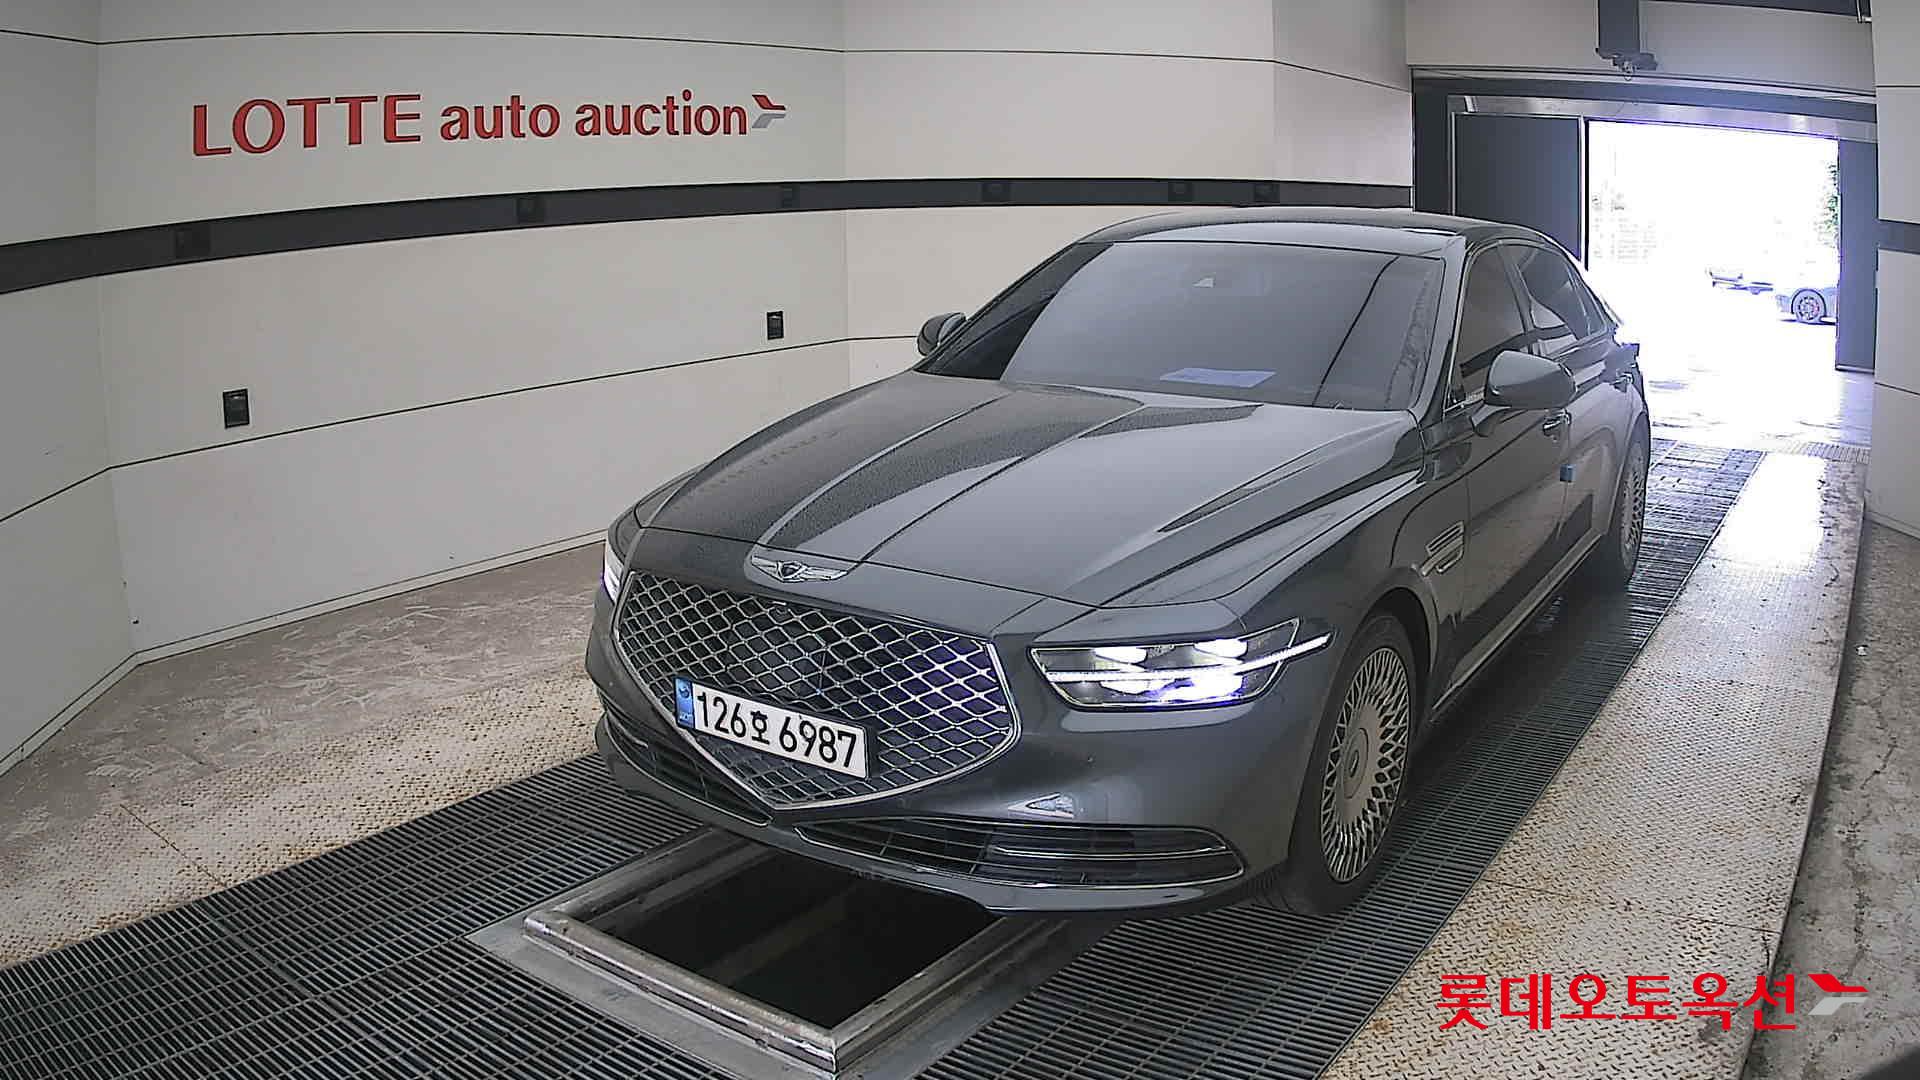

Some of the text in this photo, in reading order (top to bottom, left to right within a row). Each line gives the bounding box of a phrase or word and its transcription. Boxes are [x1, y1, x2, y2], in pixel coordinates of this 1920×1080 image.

[193, 89, 748, 157] LOTTE auto auction
[697, 691, 857, 768] 126호 6987
